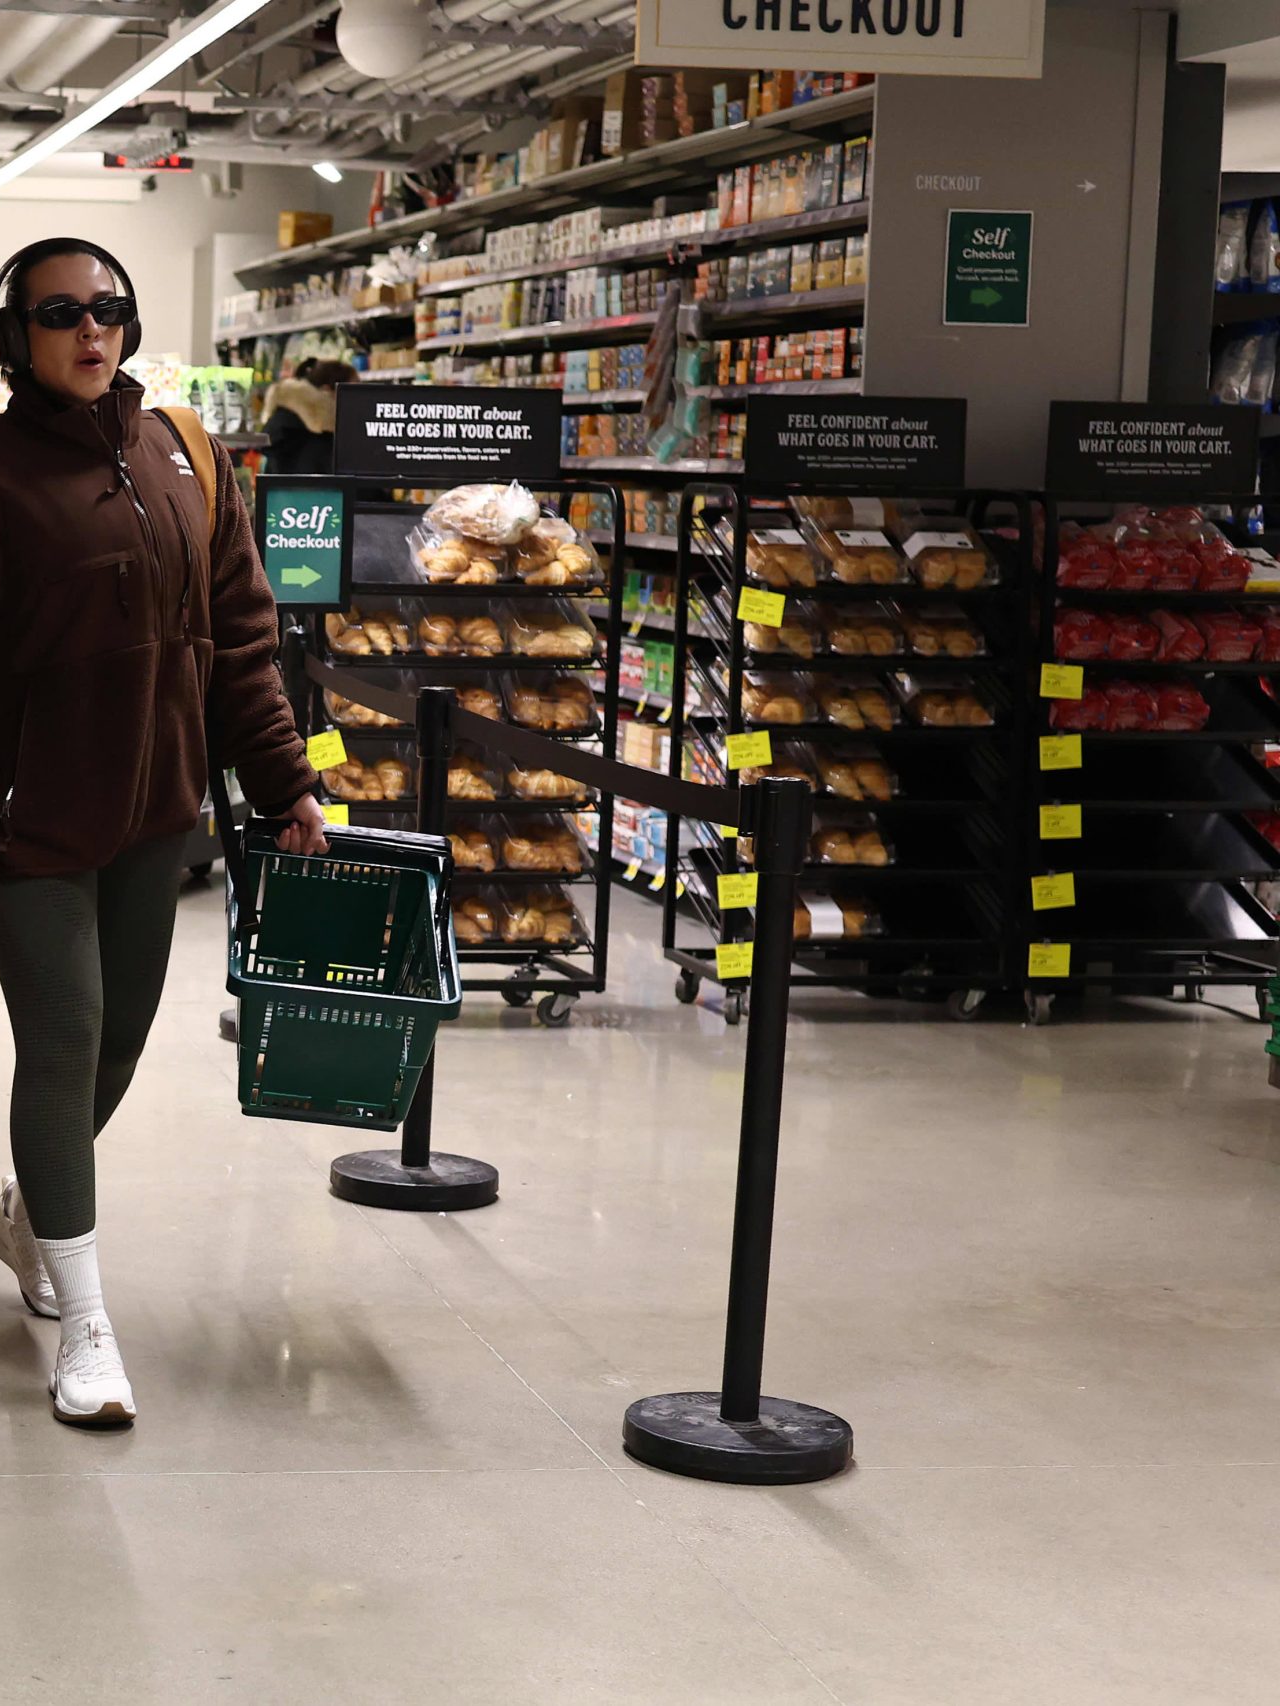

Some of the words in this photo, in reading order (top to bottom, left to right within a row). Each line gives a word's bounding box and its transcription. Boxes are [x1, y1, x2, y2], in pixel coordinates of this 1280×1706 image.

[916, 175, 981, 191] CHECKOUT
[971, 227, 1011, 249] Self
[962, 248, 1016, 260] Checkout
[375, 402, 408, 419] FEEL
[409, 404, 481, 420] CONFIDENT
[483, 406, 522, 421] about
[365, 421, 405, 437] WHAT
[407, 423, 441, 438] GOES
[443, 423, 457, 438] IN
[459, 424, 494, 439] YOUR
[496, 425, 533, 440] CART.
[788, 414, 818, 429] FEEL
[821, 415, 889, 430] CONFIDENT
[891, 417, 928, 431] about
[1089, 420, 1118, 435] FEEL
[1121, 421, 1186, 436] CONFIDENT
[1188, 423, 1224, 437] about
[777, 432, 815, 446] WHAT
[817, 433, 850, 447] GOES
[852, 434, 865, 448] IN
[867, 434, 900, 448] YOUR
[903, 435, 939, 449] CART.
[1078, 438, 1114, 453] WHAT
[1116, 439, 1147, 453] GOES
[1150, 440, 1162, 454] IN
[1165, 440, 1196, 454] YOUR
[1199, 441, 1232, 455] CART.
[279, 505, 333, 534] Self
[266, 534, 341, 549] Checkout
